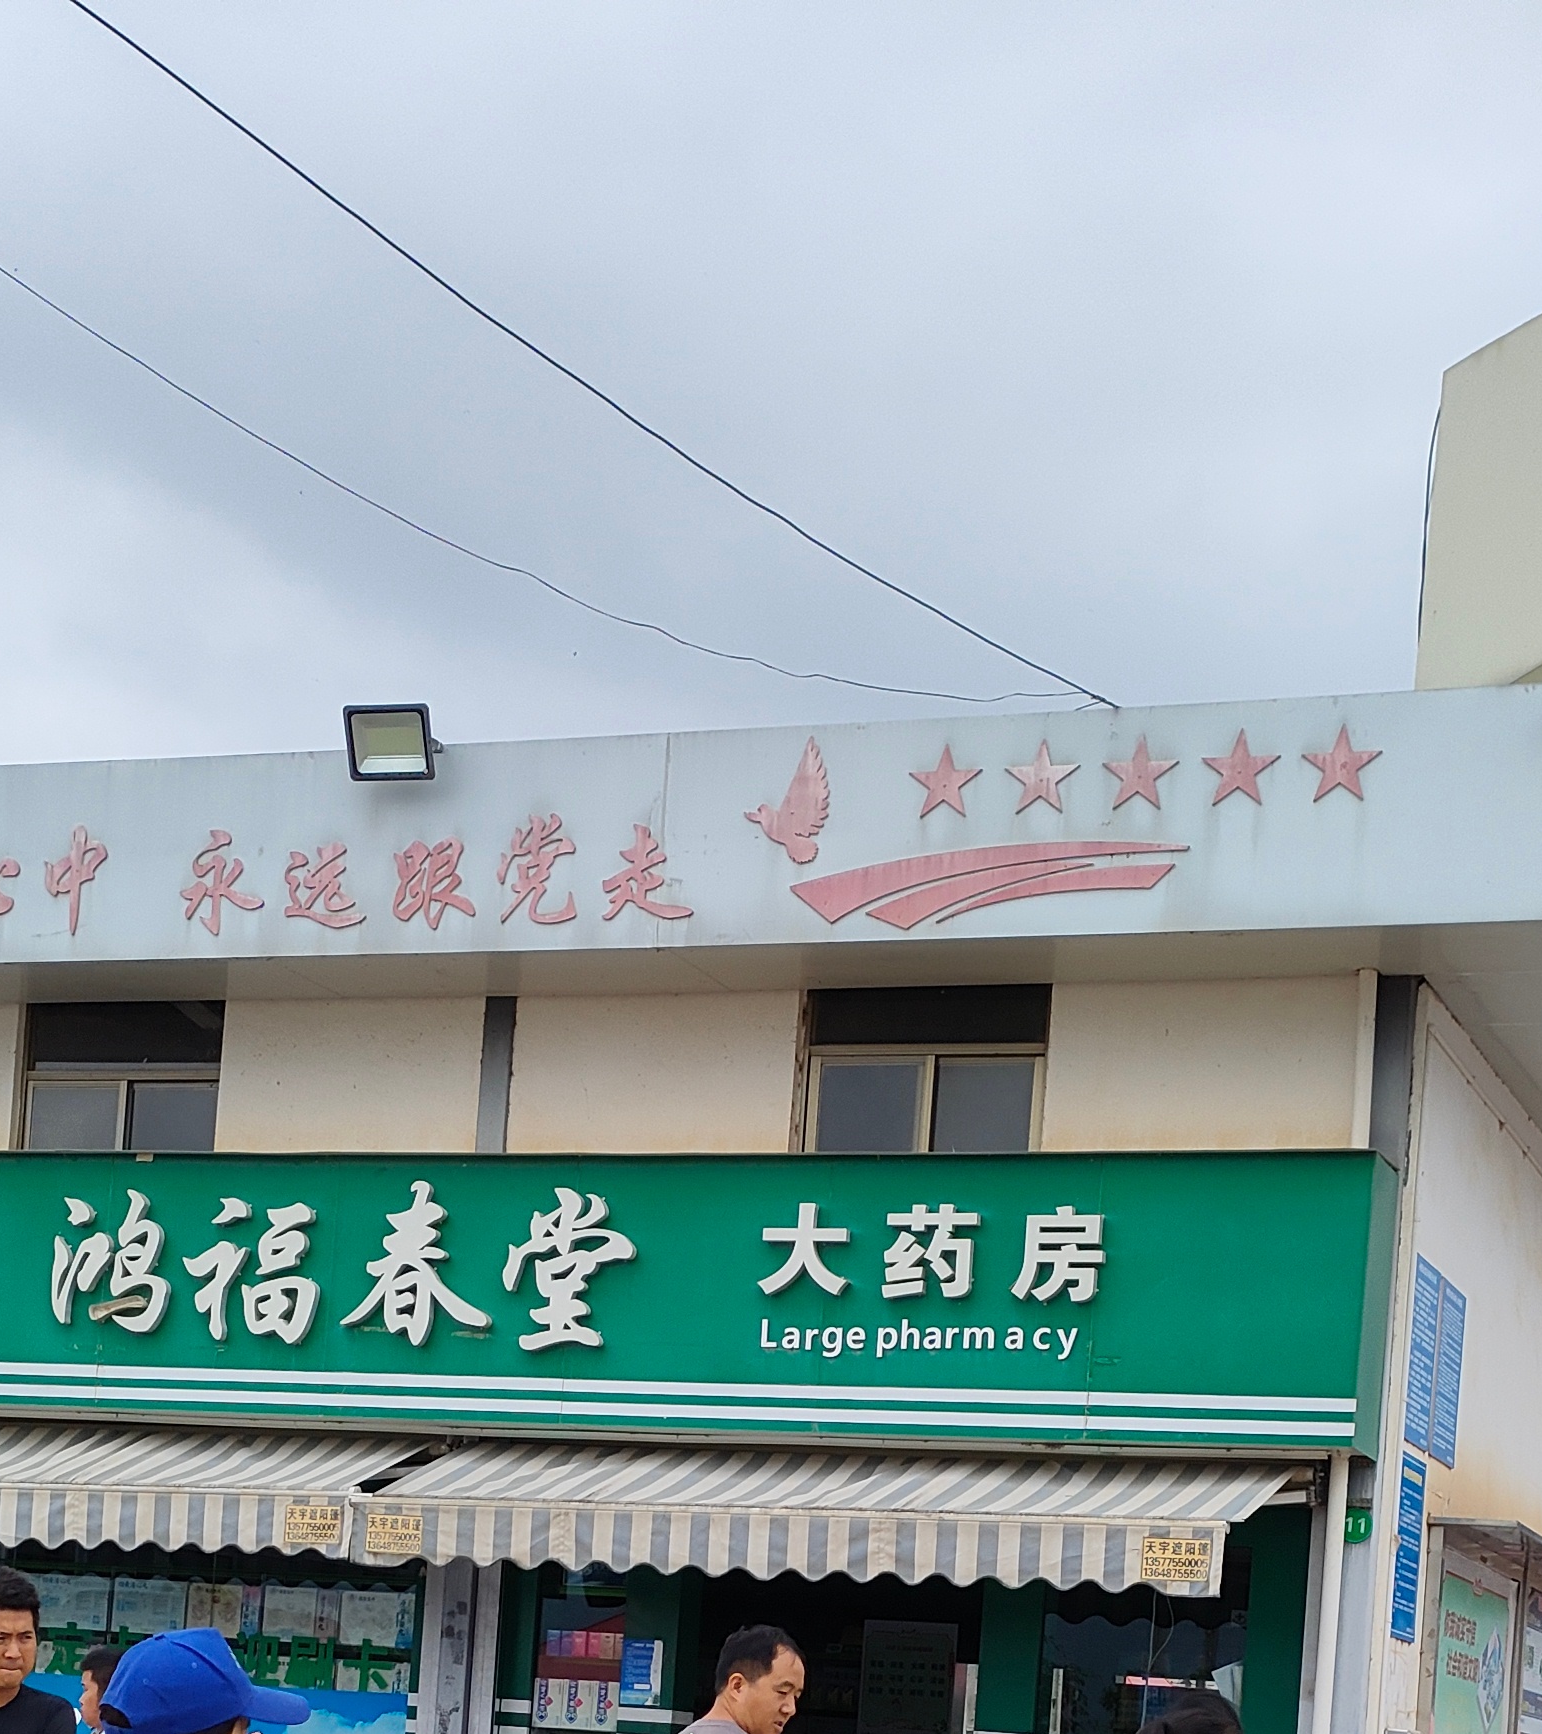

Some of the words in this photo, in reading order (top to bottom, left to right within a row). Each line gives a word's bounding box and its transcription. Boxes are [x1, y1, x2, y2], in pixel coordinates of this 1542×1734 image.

[178, 811, 694, 936] 永远跟党走
[51, 1179, 638, 1352] 鸿福春堂
[756, 1200, 1107, 1304] 大药房
[760, 1318, 866, 1358] Large
[1345, 1516, 1366, 1534] 11
[1143, 1557, 1208, 1568] 13577550005
[1143, 1567, 1207, 1579] 13648755500
